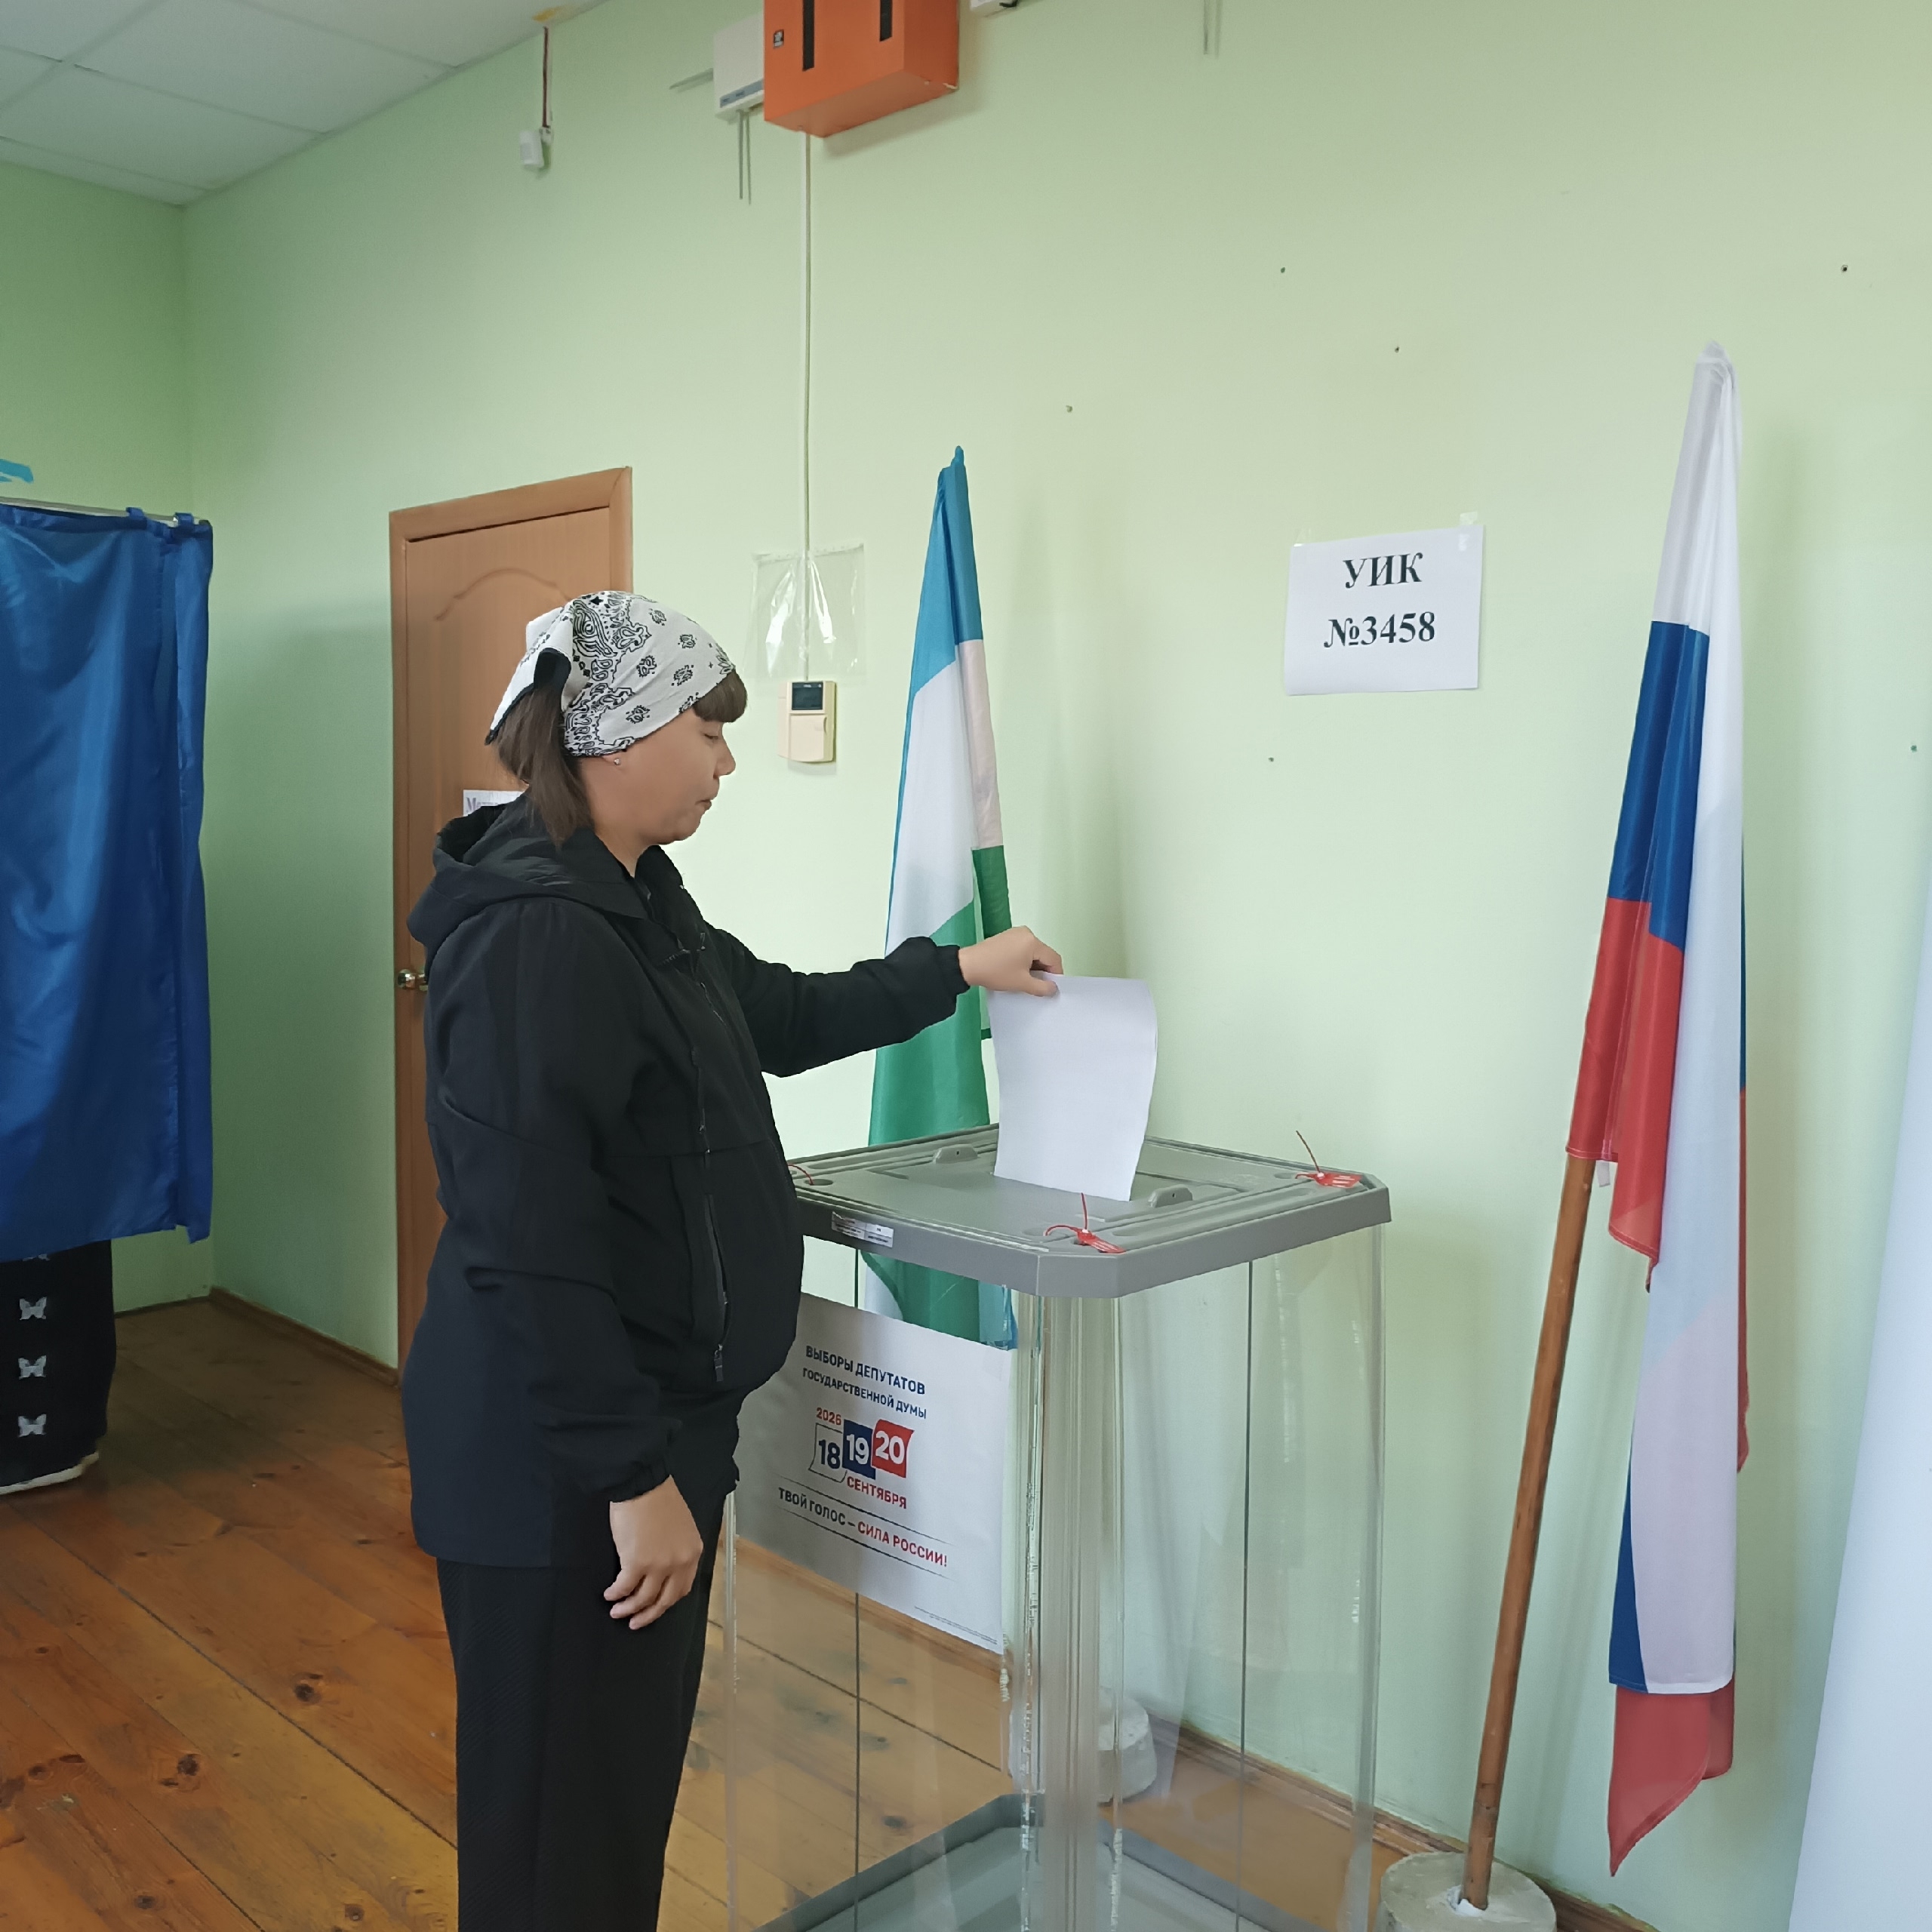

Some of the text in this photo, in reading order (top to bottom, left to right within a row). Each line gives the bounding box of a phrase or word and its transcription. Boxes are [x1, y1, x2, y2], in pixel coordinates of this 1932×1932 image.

[1343, 552, 1423, 589] УИК
[1323, 611, 1435, 648] №3458
[805, 1345, 926, 1395] ВЫБОРЫ ДЕПУТАТОВ
[802, 1367, 927, 1420] ГОСУДАРСТВЕННОЙ ДУМЫ
[816, 1407, 841, 1426] 2026
[818, 1431, 906, 1469] 18 19 20
[847, 1475, 907, 1509] СЕНТЯБРЯ
[778, 1487, 808, 1510] ТВОЙ
[809, 1500, 846, 1526] ГОЛОС
[857, 1521, 890, 1544] СИЛА
[892, 1534, 947, 1567] РОССИИ!
